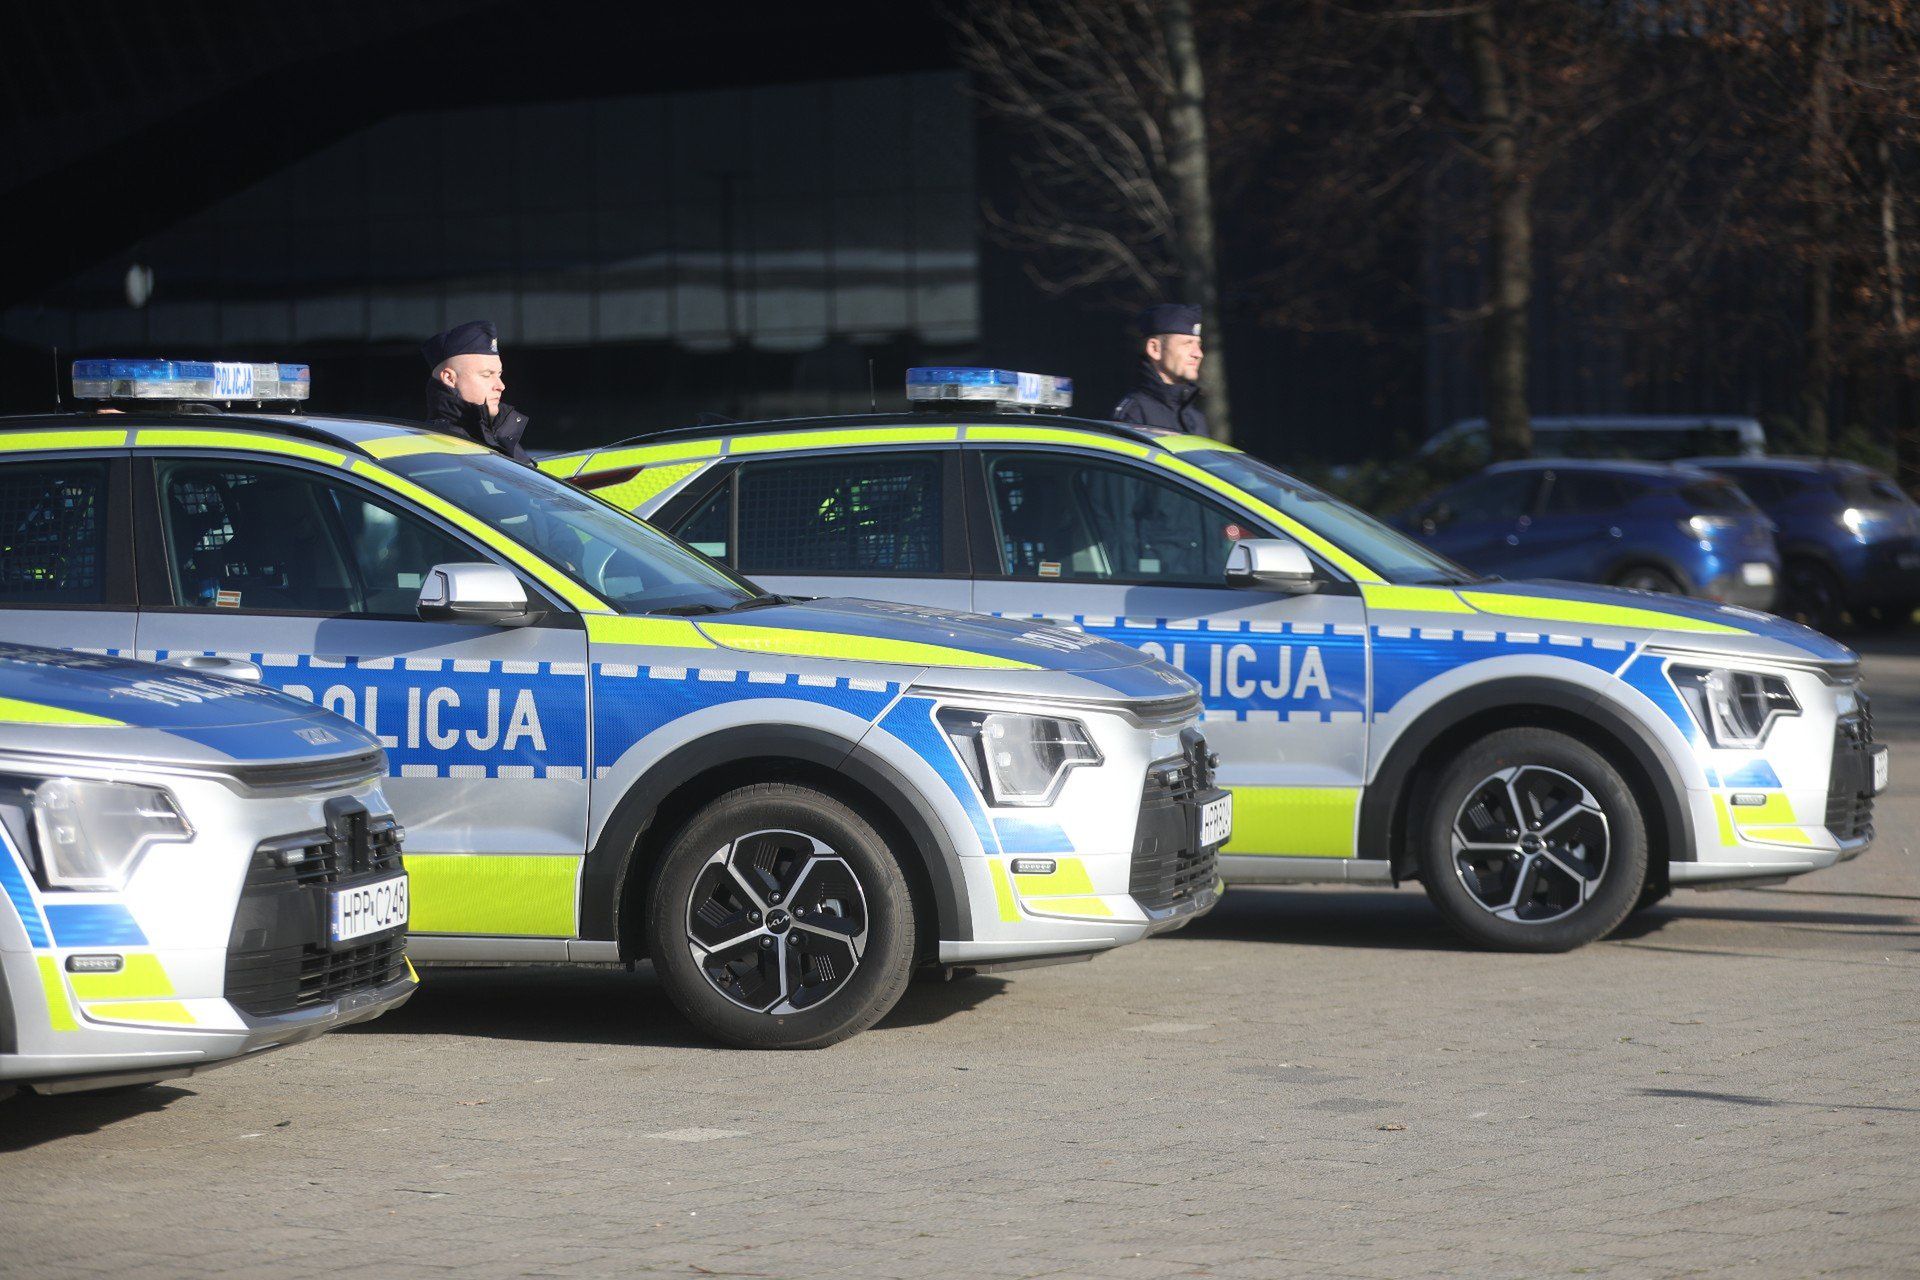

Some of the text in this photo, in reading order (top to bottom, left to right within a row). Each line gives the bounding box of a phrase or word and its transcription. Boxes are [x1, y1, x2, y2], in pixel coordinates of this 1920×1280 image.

[215, 367, 252, 395] POLICJA
[1138, 641, 1332, 700] ICJA
[343, 881, 405, 935] HPP C248
